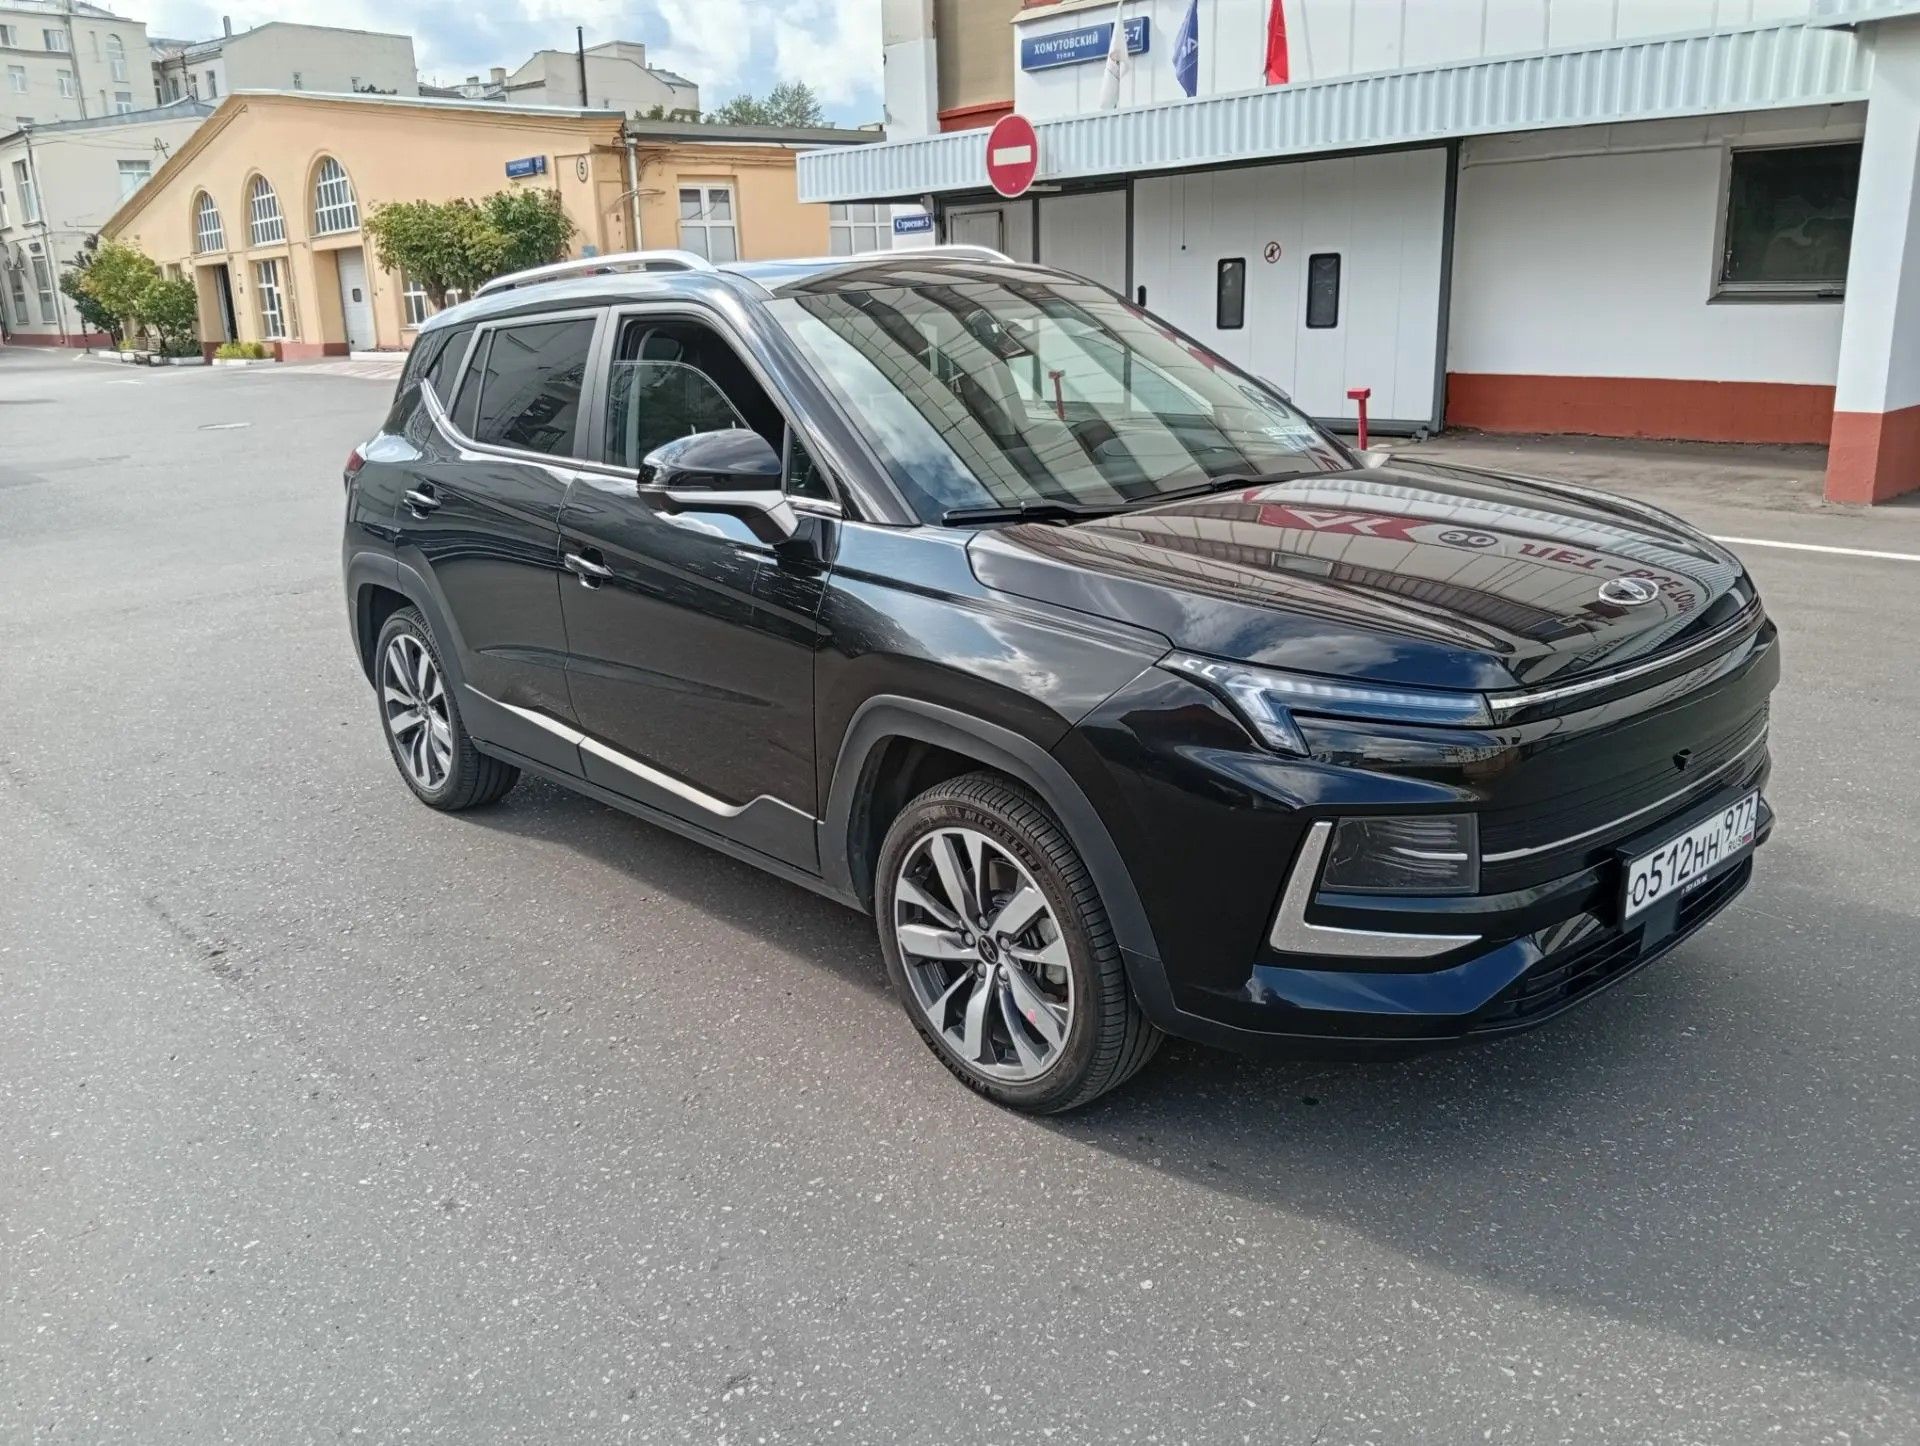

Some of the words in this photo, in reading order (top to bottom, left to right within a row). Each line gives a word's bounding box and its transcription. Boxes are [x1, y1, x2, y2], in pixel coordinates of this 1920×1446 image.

[1034, 31, 1098, 55] ХОМУТОВСКИЙ
[1725, 796, 1753, 843] 977
[1727, 834, 1743, 854] RUS
